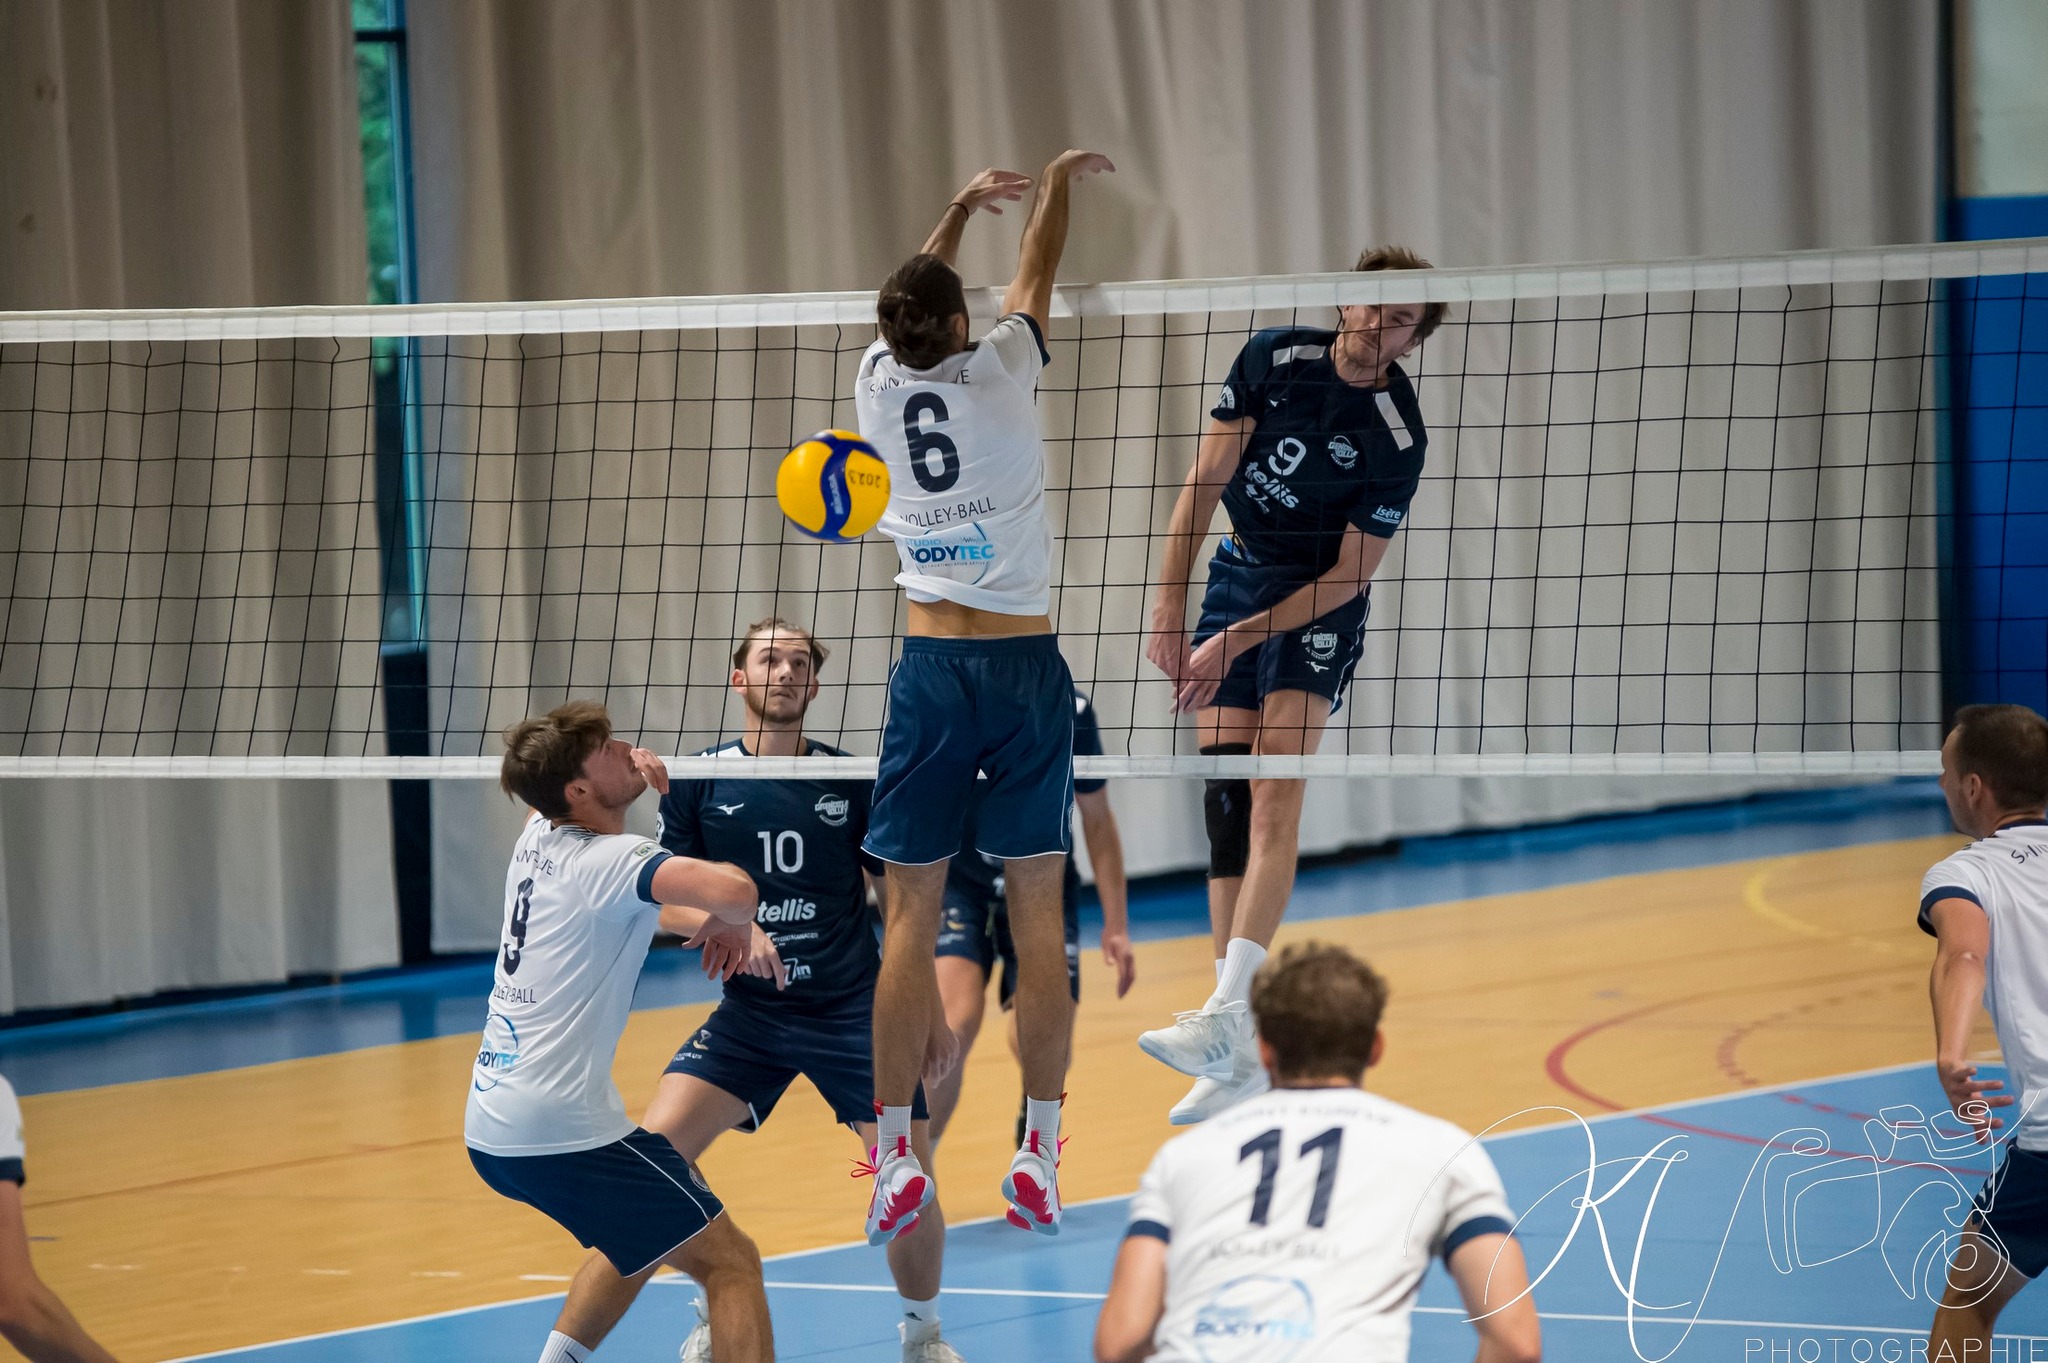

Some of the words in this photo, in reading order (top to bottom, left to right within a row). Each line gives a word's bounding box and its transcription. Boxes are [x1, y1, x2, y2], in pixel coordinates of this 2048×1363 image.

[903, 391, 960, 493] 6
[1268, 437, 1307, 476] 9
[1376, 504, 1401, 520] isère
[757, 830, 804, 874] 10
[503, 877, 534, 977] 9
[757, 898, 816, 923] tellis
[1238, 1126, 1344, 1229] 11
